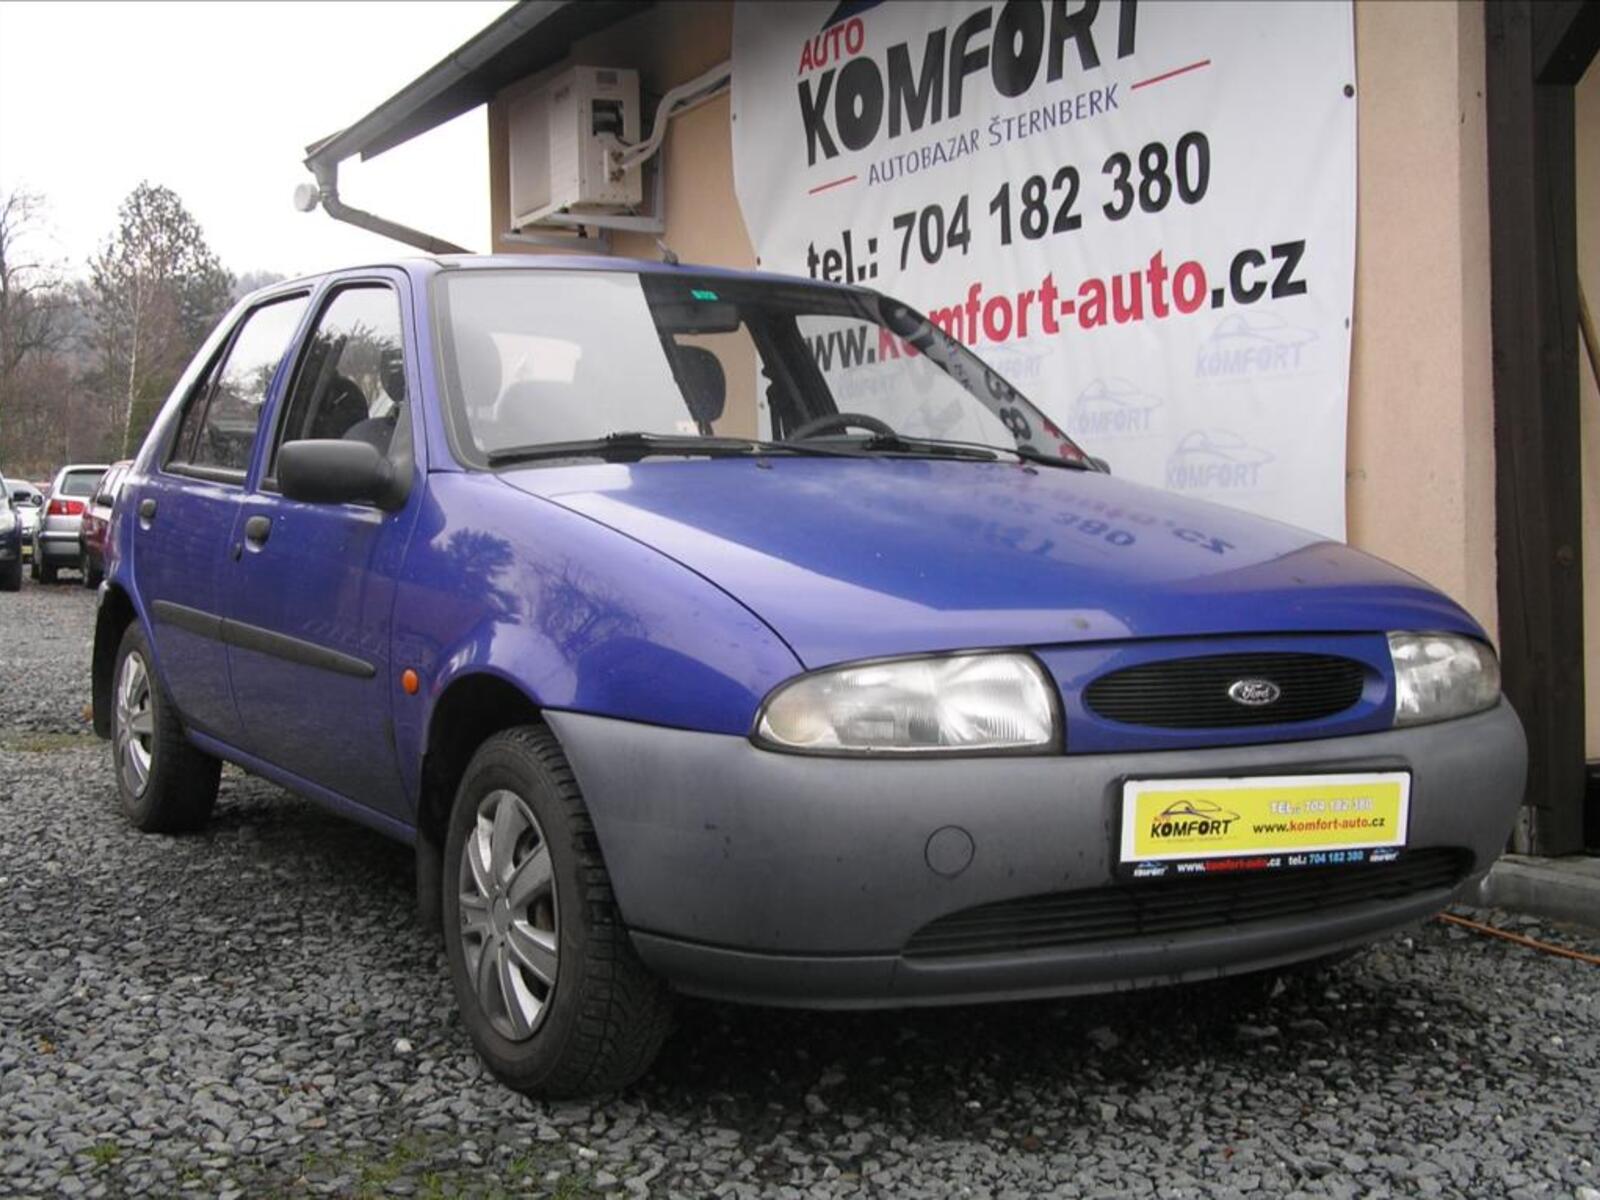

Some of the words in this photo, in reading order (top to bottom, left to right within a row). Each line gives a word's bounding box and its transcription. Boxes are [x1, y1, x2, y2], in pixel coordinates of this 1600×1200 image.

[798, 16, 865, 76] AUTO
[868, 128, 980, 186] AUTOBAZAR
[988, 83, 1119, 148] ŠTERNBERK
[807, 229, 878, 285] tel.:
[893, 195, 971, 272] 704
[989, 165, 1082, 246] 182
[1101, 131, 1211, 221] 380
[1195, 342, 1304, 377] KOMFORT
[1067, 407, 1153, 435] KOMFORT
[1165, 463, 1263, 490] KOMFORT
[1150, 820, 1232, 838] KOMFORT
[1253, 817, 1386, 833] www.komfort-auto.cz
